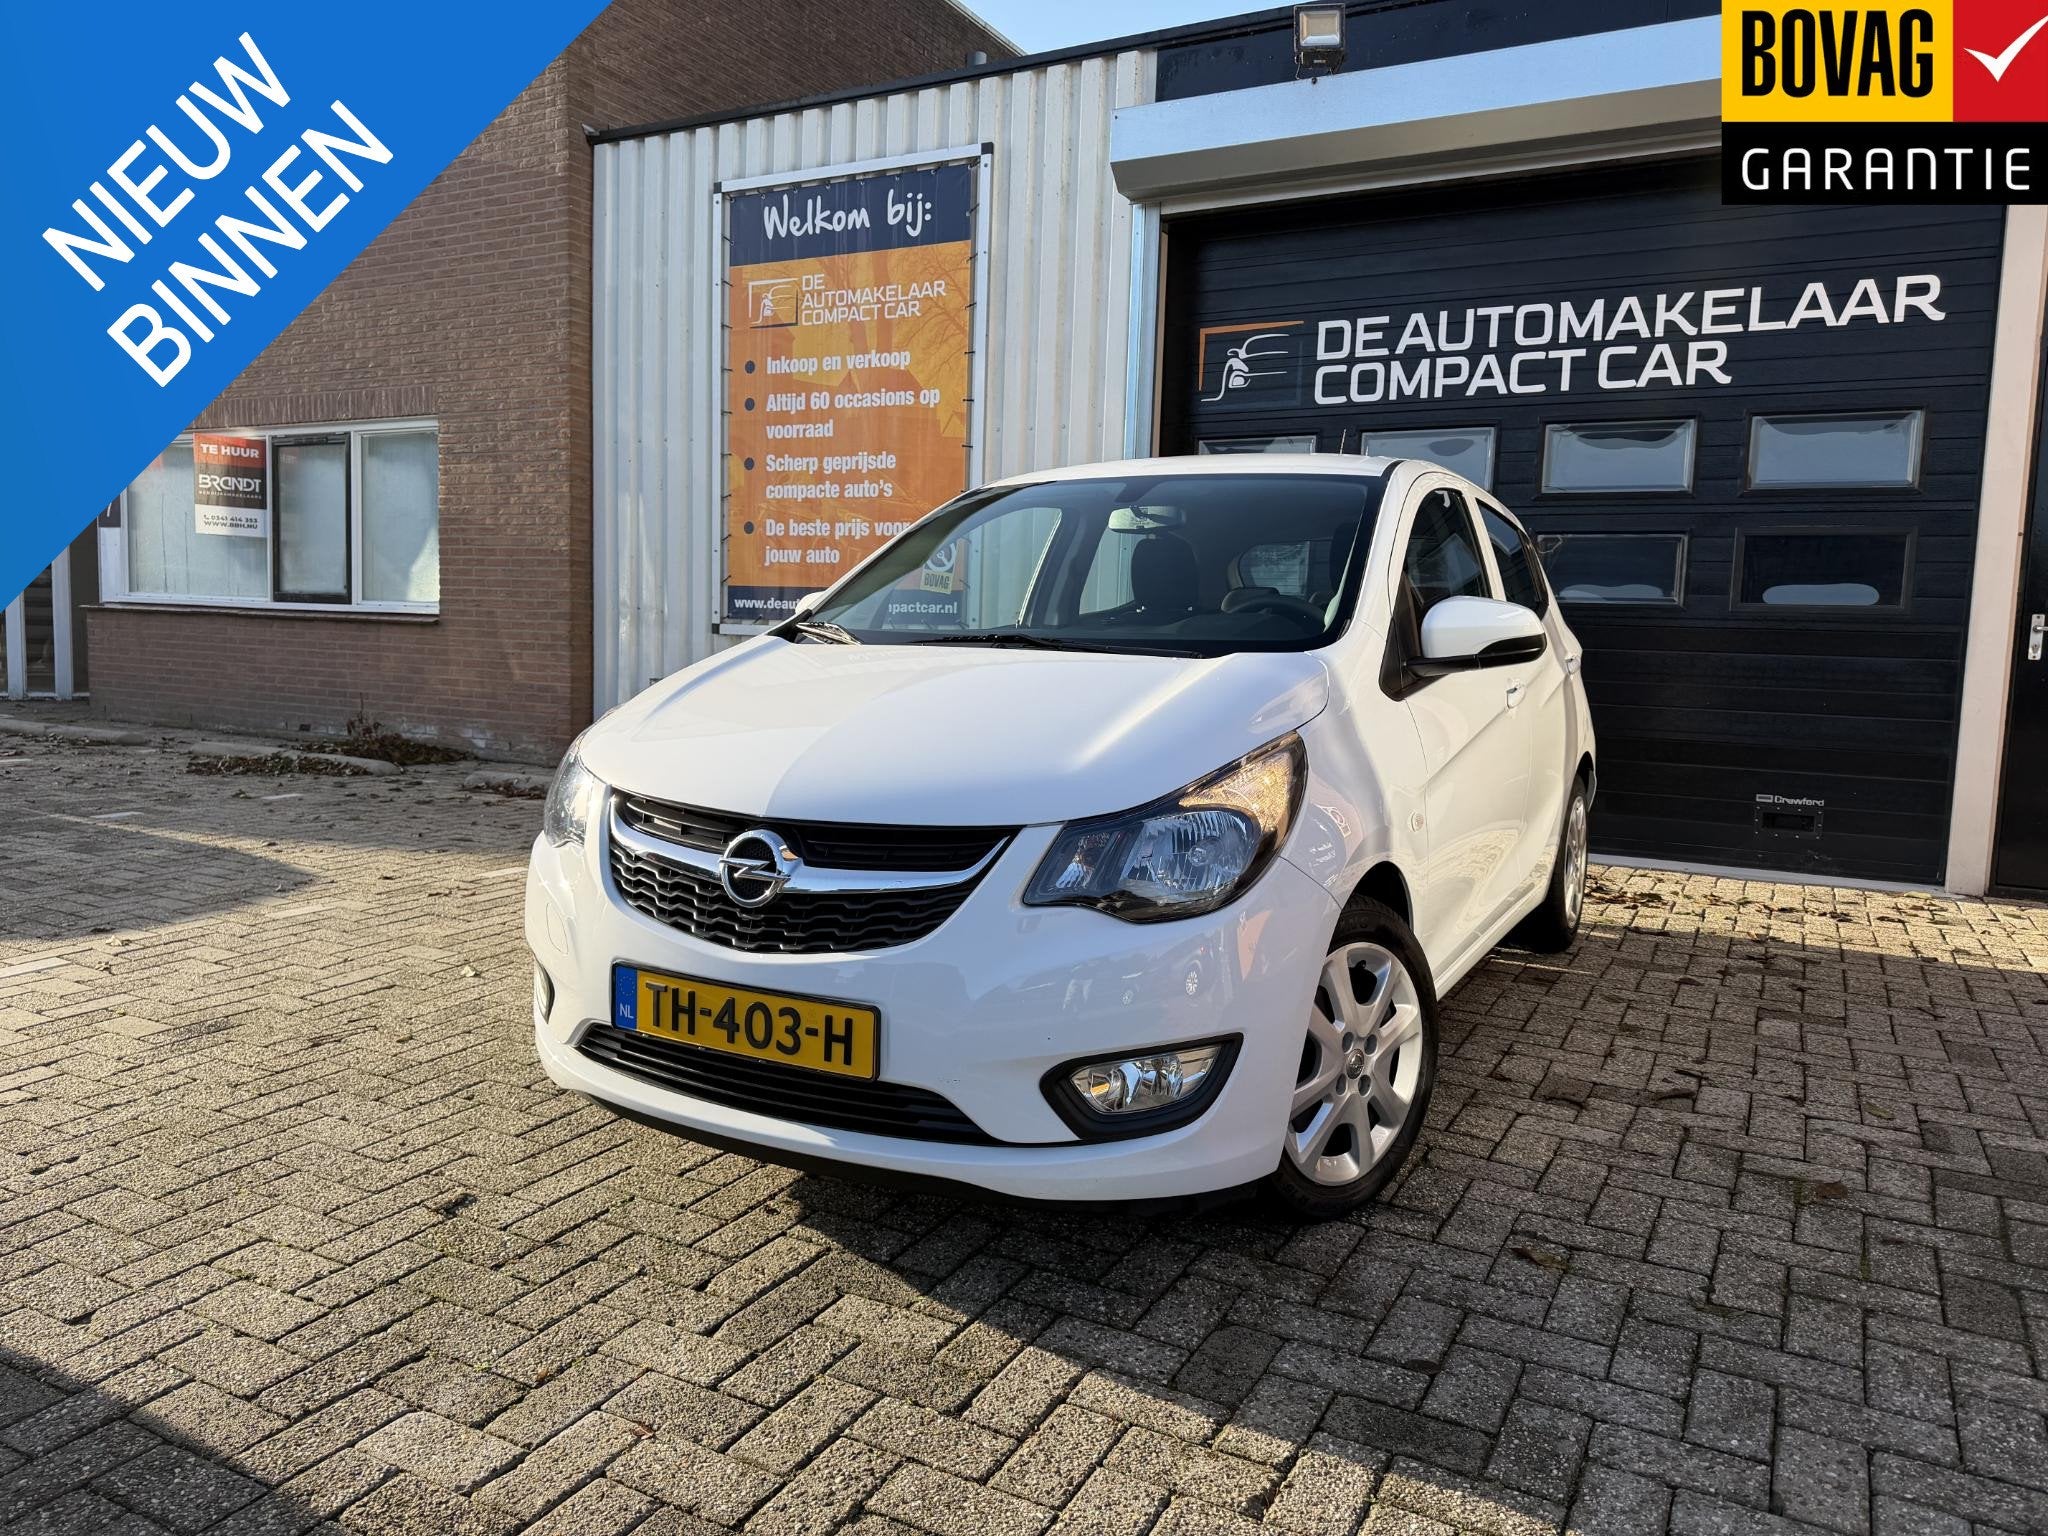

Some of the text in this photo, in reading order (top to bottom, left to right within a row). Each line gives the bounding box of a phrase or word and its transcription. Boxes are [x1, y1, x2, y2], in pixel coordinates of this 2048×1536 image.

[763, 188, 932, 240] Welkom bij:
[801, 274, 825, 291] DE
[801, 280, 947, 310] AUTOMAKELAAR
[801, 300, 922, 326] COMPACT CAR
[1315, 273, 1947, 361] DE AUTOMAKELAAR
[766, 350, 911, 375] Inkoop en verkoop
[1313, 340, 1734, 406] COMPACT CAR
[766, 388, 941, 414] Altijd 60 occasions op
[766, 419, 834, 440] voorraad
[200, 443, 260, 459] TE HUUR
[766, 451, 897, 474] Scherp geprijsde
[198, 473, 262, 493] BRANDT
[765, 479, 893, 502] compacte auto's
[765, 518, 786, 536] De
[789, 518, 831, 536] beste
[835, 518, 870, 540] prijs
[764, 546, 841, 566] jouw auto
[924, 573, 950, 589] BOVAG
[1774, 795, 1825, 807] Crawford
[619, 980, 854, 1066] NL TH-403-H
